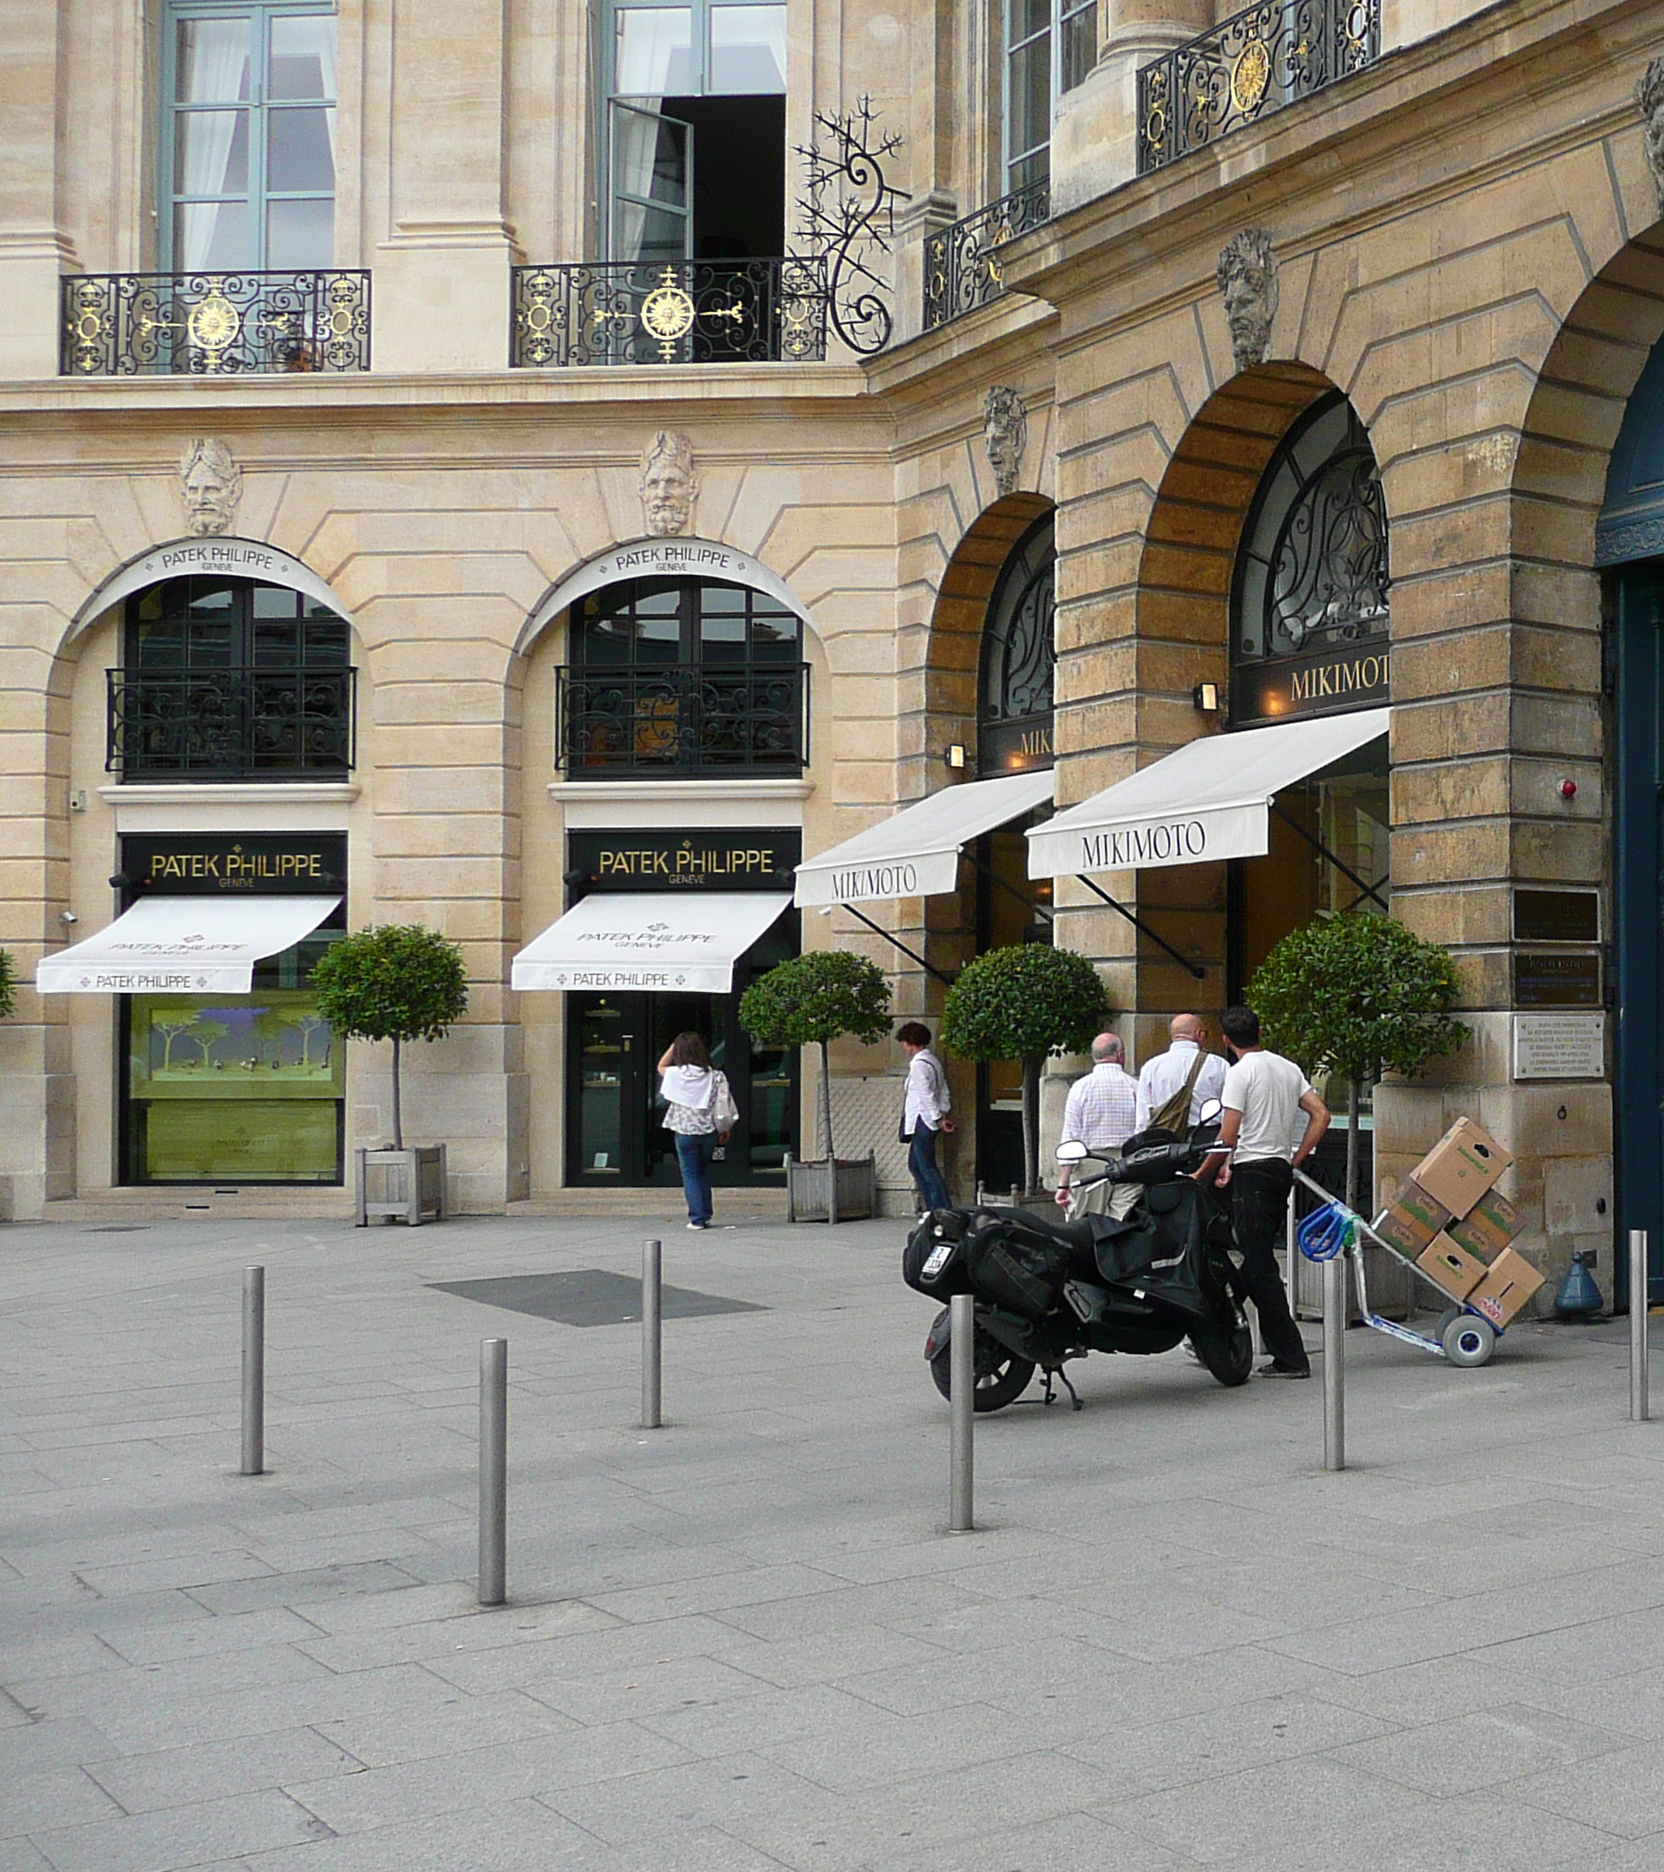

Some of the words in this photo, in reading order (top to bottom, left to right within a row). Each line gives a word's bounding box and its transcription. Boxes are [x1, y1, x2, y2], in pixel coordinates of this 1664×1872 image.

[162, 547, 208, 568] PATEK
[211, 547, 274, 570] PHILIPPE
[616, 548, 661, 570] PATEK
[665, 547, 731, 568] PHILIPPE
[1082, 820, 1206, 868] MIKIMOTO
[151, 854, 220, 877] PATEK
[226, 854, 322, 877] PHILIPPE
[599, 851, 670, 874] PATEK
[675, 850, 774, 873] PHILIPPE
[831, 863, 917, 900] MIKIMOTO
[577, 932, 635, 942] PATEK
[636, 933, 718, 944] PHILIPPE
[96, 975, 135, 988] PATEK
[138, 975, 191, 988] PHILIPPE
[573, 973, 612, 986] PATEK
[614, 973, 669, 986] PHILIPPE
